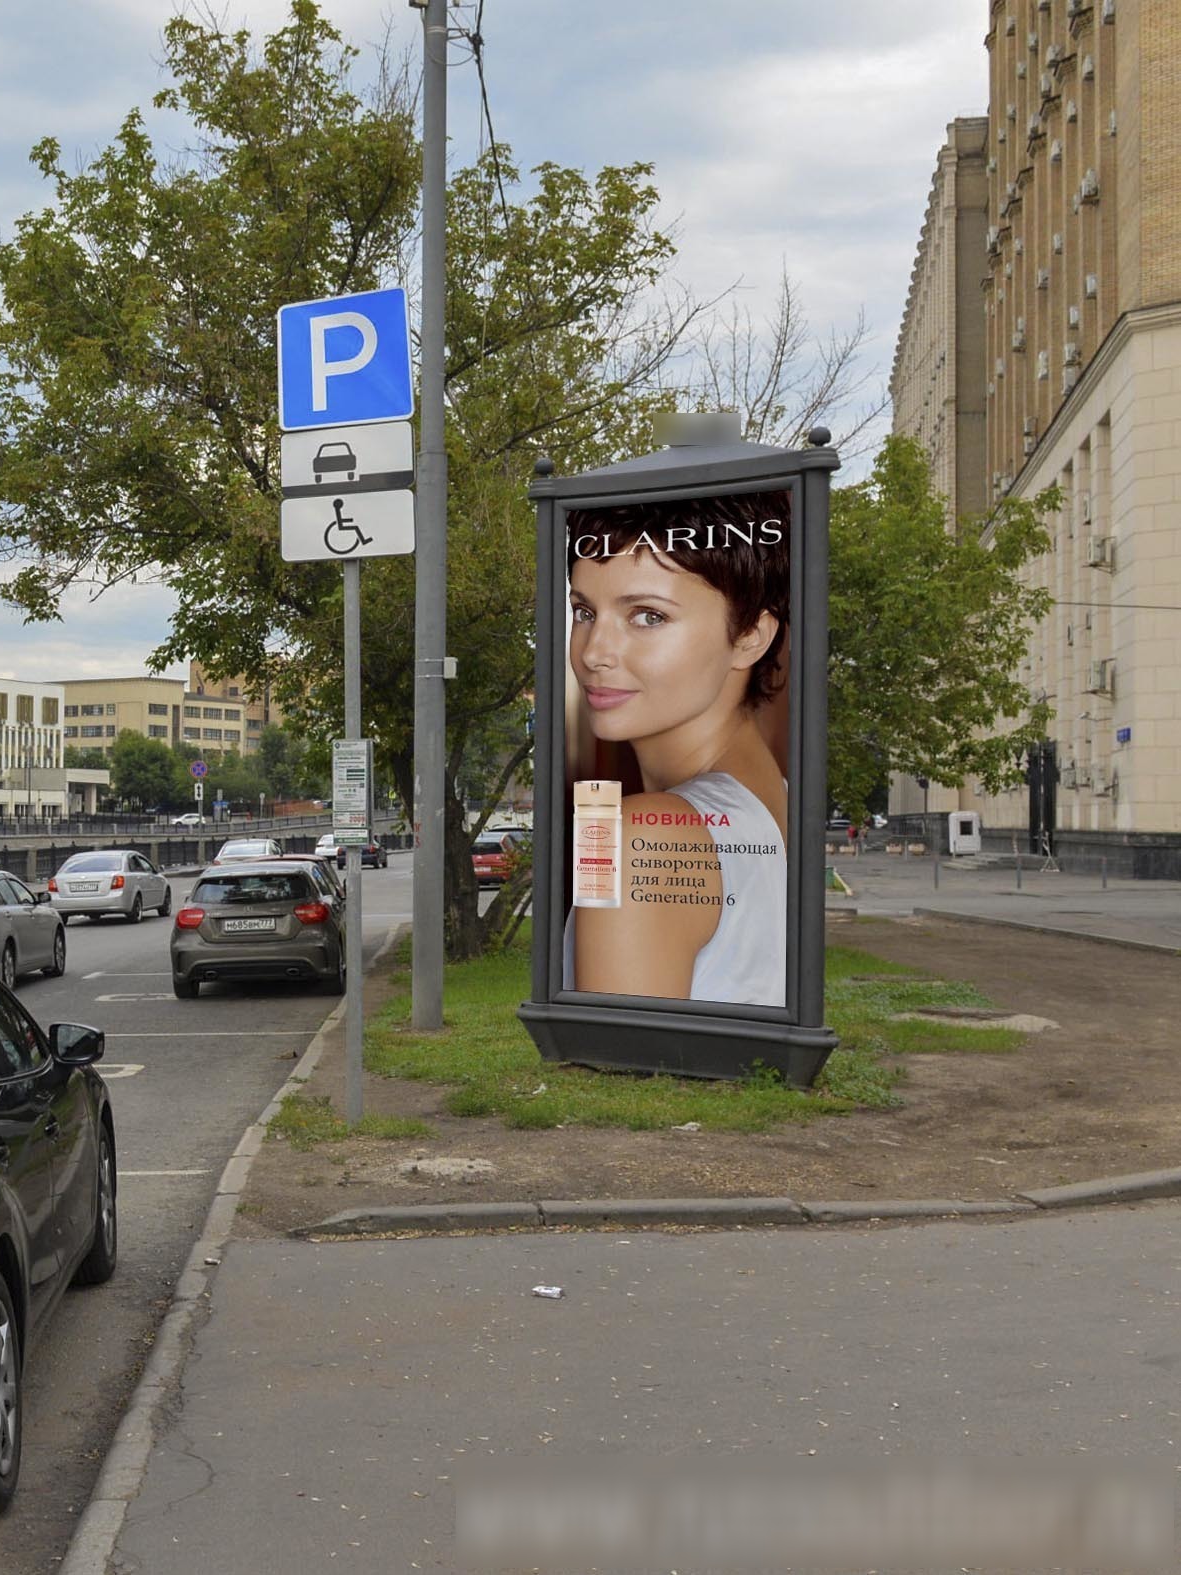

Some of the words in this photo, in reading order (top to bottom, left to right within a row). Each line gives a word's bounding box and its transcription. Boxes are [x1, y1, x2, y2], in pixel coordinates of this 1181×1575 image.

[309, 311, 378, 412] P
[574, 519, 783, 559] CLARINS
[631, 812, 730, 827] НОВИНКА
[631, 837, 777, 856] Омолаживающая
[631, 857, 723, 872] сыворотка
[631, 875, 659, 887] для
[664, 876, 706, 889] лица
[631, 888, 722, 906] Generation
[726, 893, 736, 906] 6
